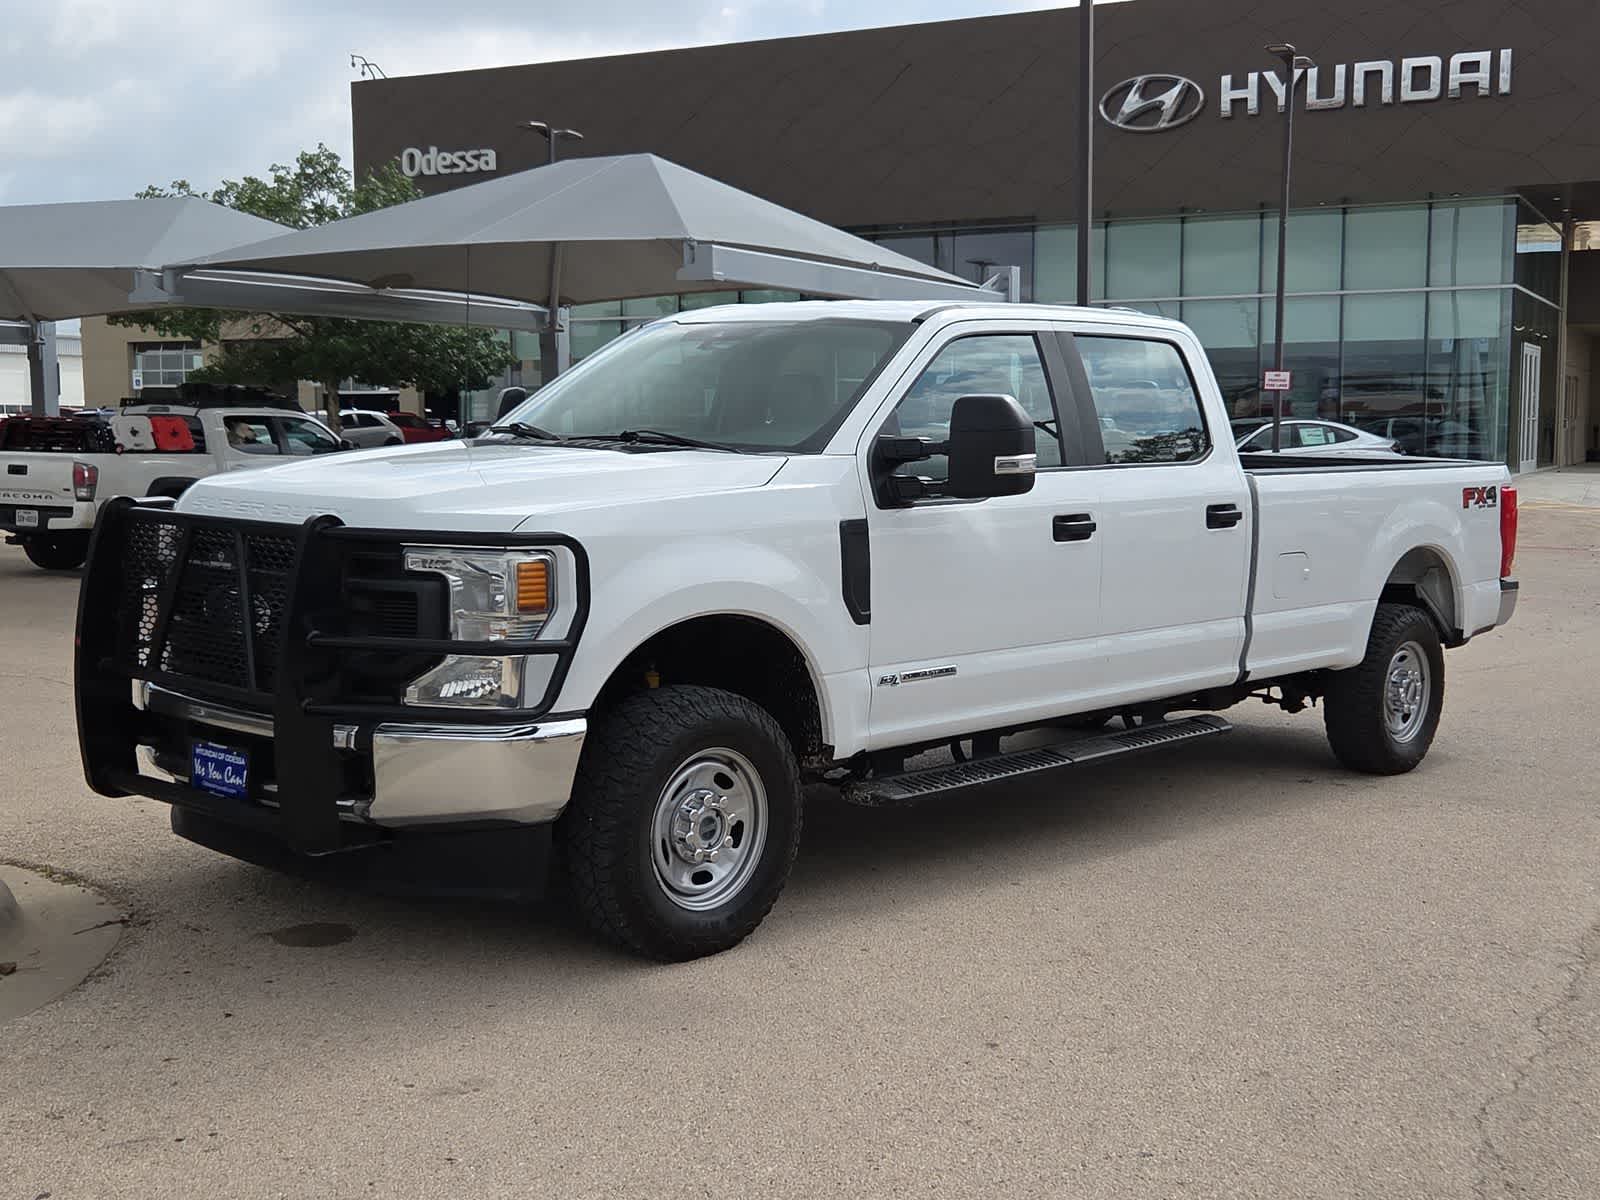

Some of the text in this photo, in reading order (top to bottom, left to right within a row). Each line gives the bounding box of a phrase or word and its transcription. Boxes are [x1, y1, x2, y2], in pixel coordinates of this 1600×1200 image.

[1219, 48, 1513, 118] HYUNDAI
[402, 146, 497, 177] Odessa
[0, 492, 54, 500] ACOMA
[191, 496, 265, 518] SUPER
[1462, 485, 1497, 509] FX4
[194, 757, 206, 776] Yes
[208, 761, 222, 780] You
[224, 766, 247, 788] Can!
